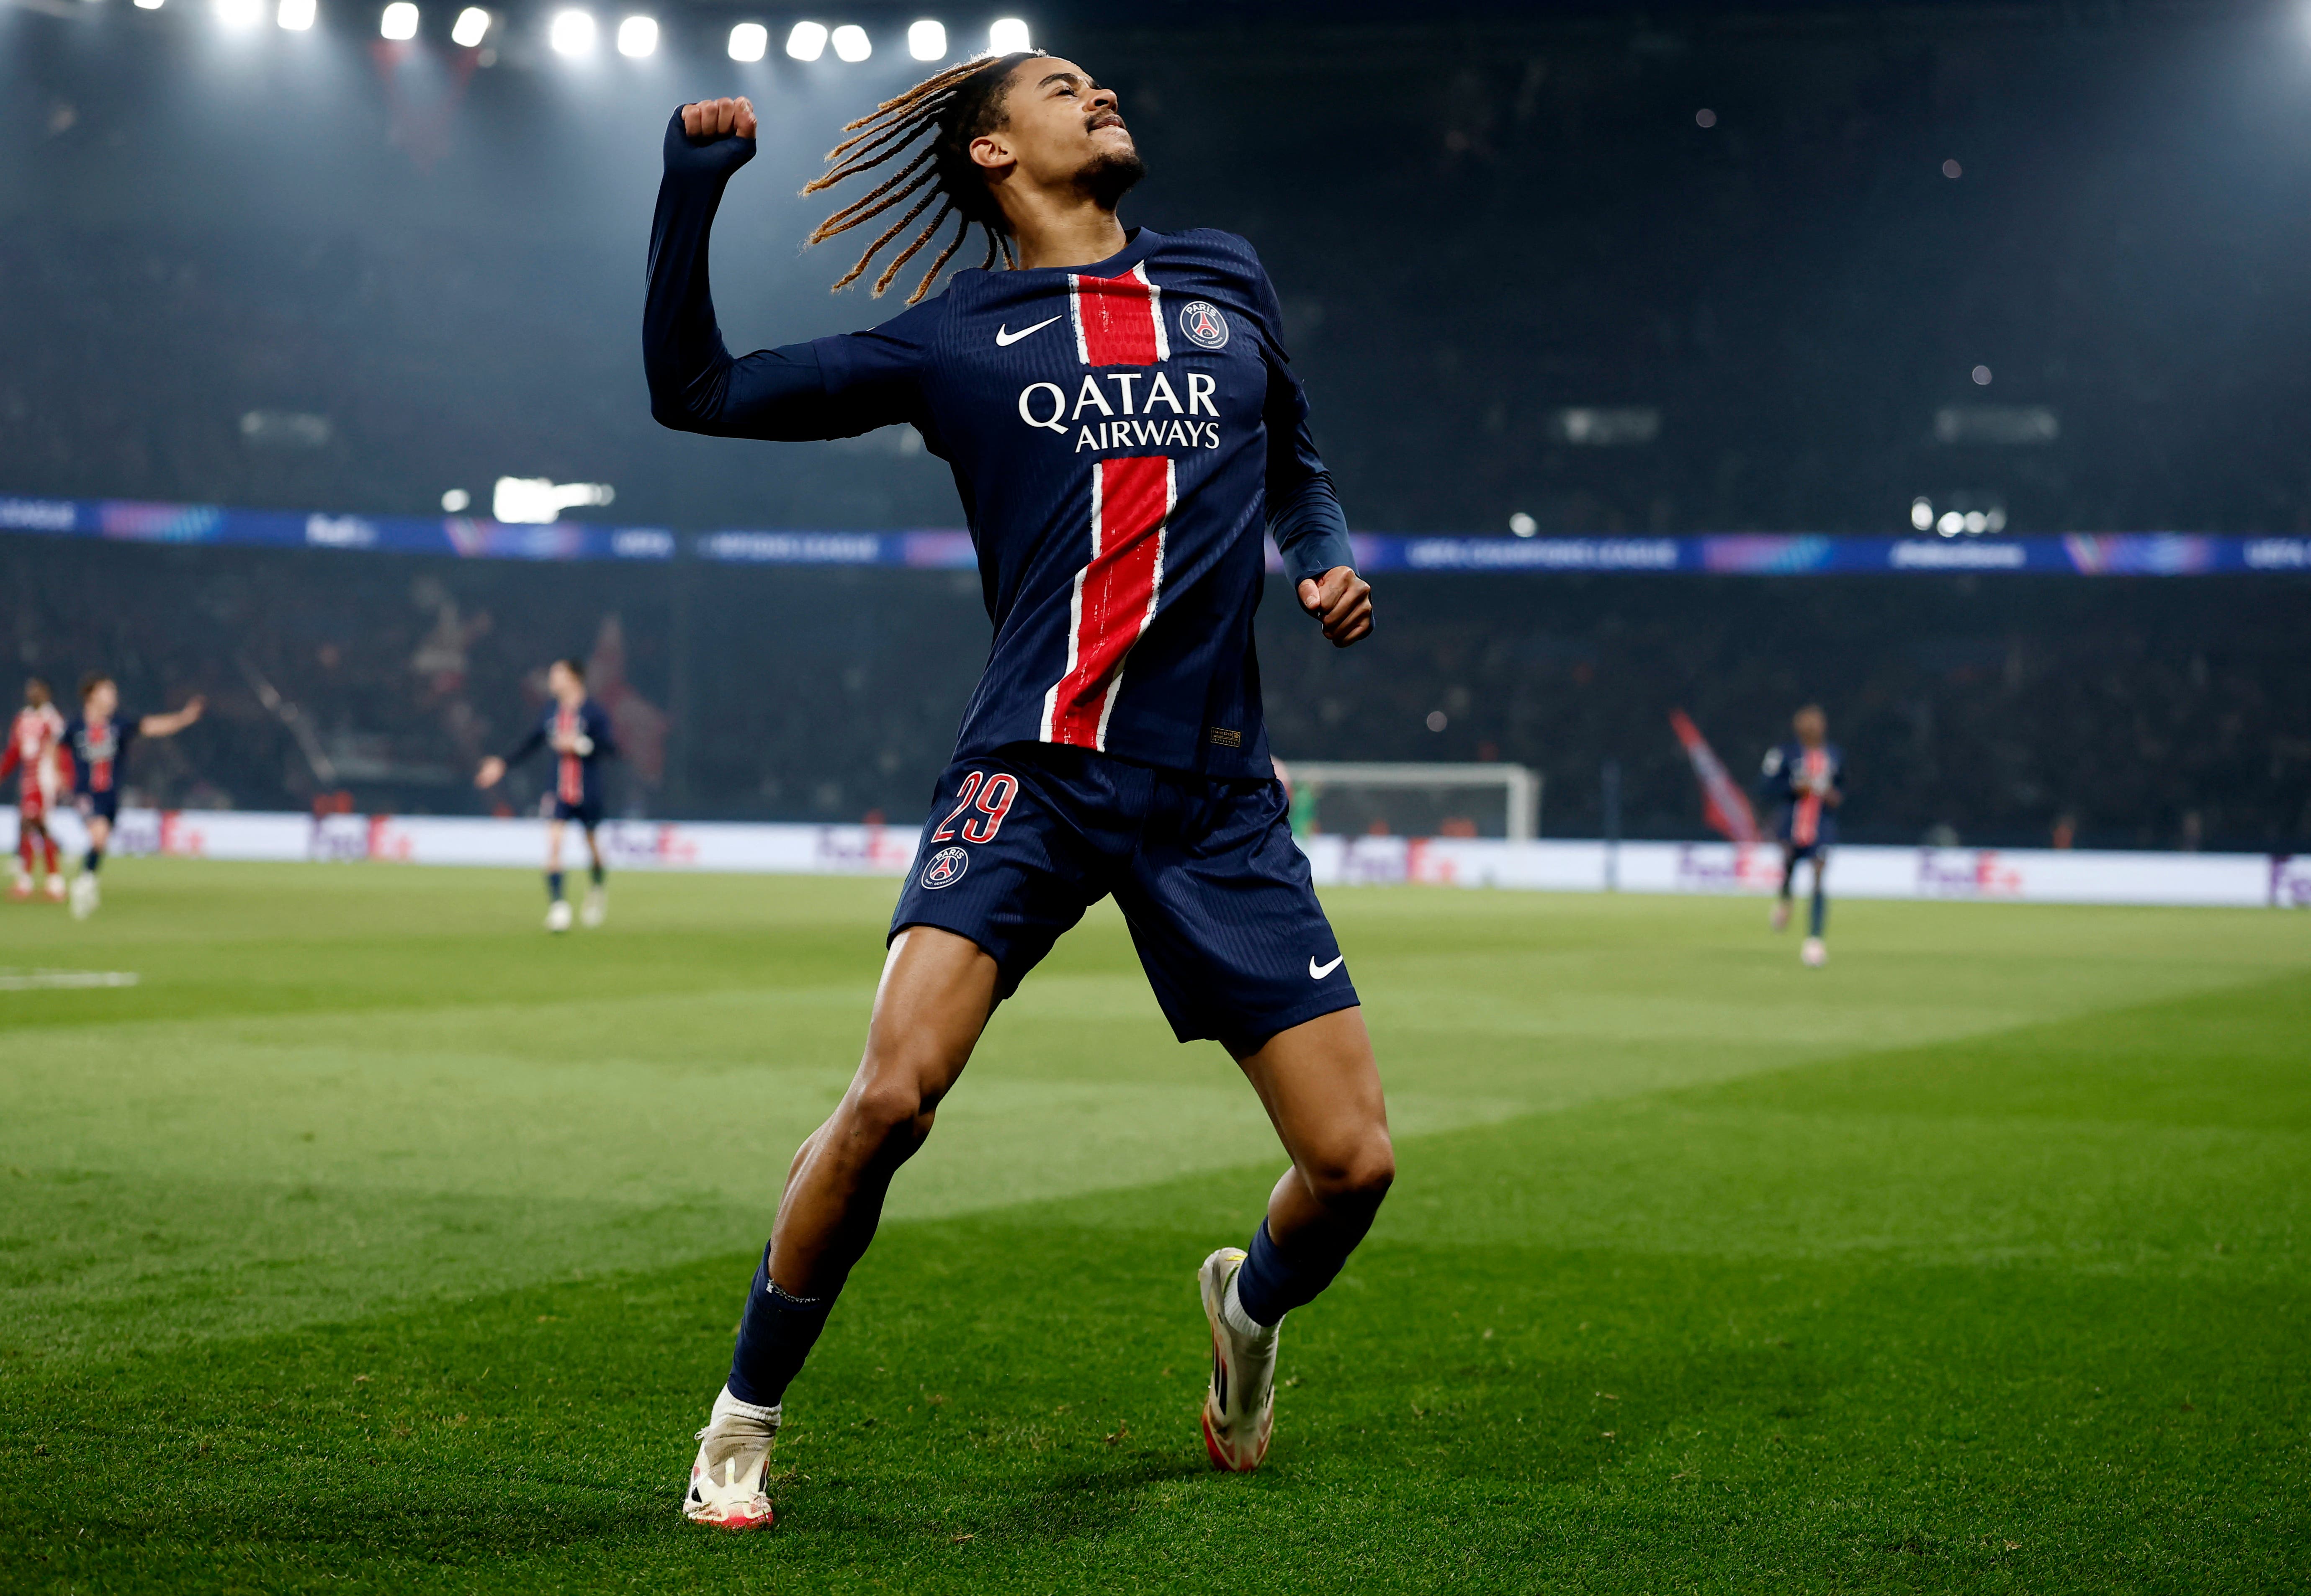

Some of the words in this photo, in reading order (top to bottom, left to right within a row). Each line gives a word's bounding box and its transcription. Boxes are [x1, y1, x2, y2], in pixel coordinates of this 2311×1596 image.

[1186, 303, 1217, 316] PARIS
[1018, 371, 1220, 434] QATAR
[1075, 420, 1220, 453] AIRWAYS
[930, 771, 1019, 844] 29
[936, 849, 964, 861] PARIS
